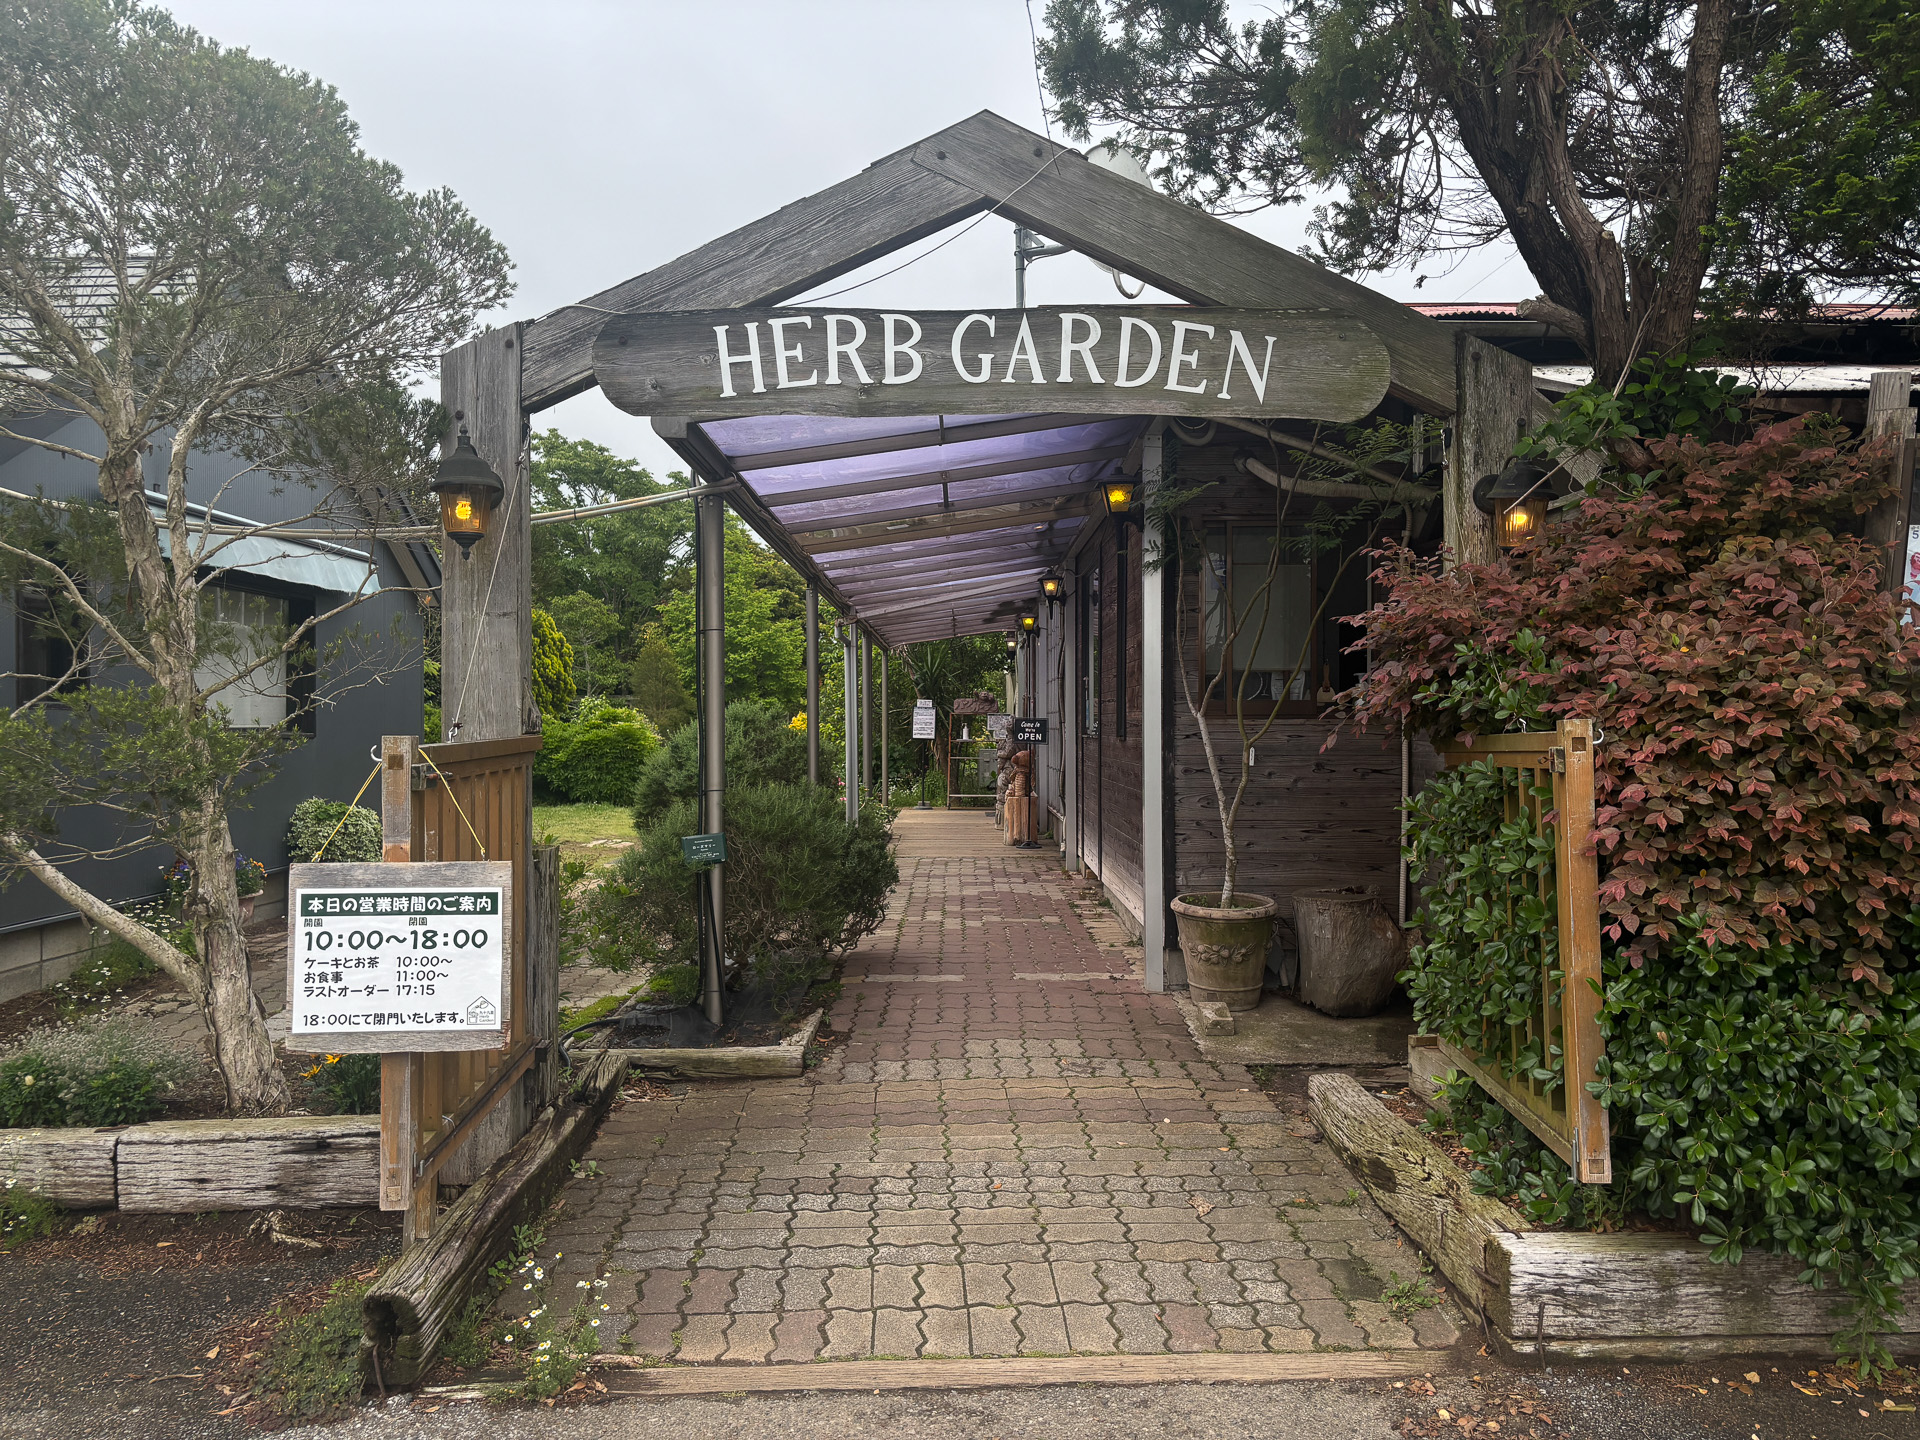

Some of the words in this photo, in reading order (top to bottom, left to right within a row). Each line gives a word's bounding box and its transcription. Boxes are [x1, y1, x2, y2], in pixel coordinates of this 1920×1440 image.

[712, 312, 924, 399] HERB
[951, 312, 1277, 405] GARDEN
[1017, 732, 1042, 741] OPEN
[307, 896, 492, 913] 本日の営業時間のご案内
[303, 918, 323, 927] 開園
[408, 917, 428, 926] 閉園
[304, 956, 380, 969] ケーキとお茶
[304, 971, 343, 983] お食事
[303, 984, 389, 998] ラストオーダー
[396, 984, 435, 996] 17:15
[303, 1012, 465, 1026] 18:00にて閉門いたします。
